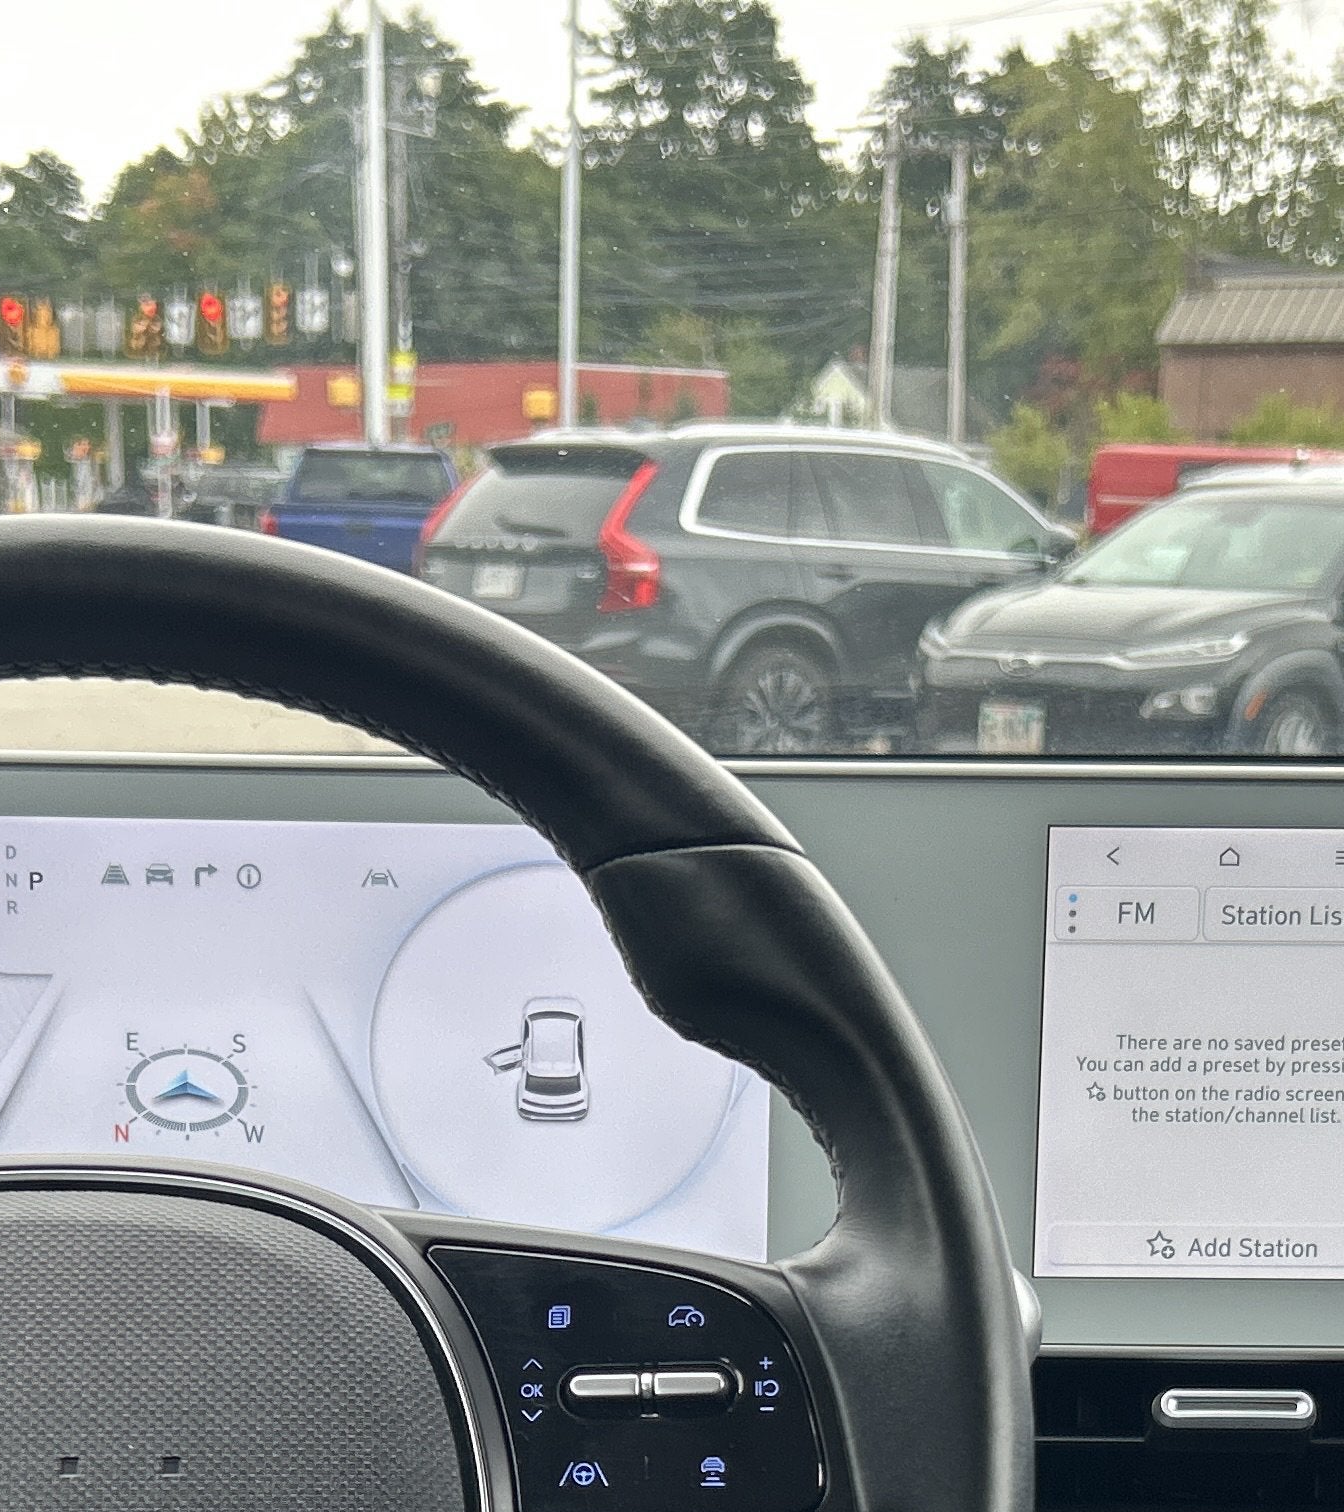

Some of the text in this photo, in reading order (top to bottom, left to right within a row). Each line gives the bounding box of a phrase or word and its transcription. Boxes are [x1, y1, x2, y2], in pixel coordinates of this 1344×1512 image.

[5, 846, 17, 860] D
[6, 872, 44, 890] N P
[6, 900, 19, 915] R
[1118, 902, 1156, 925] FM
[1221, 904, 1301, 926] Station
[126, 1032, 138, 1051] E
[233, 1033, 246, 1053] S
[1117, 1034, 1167, 1052] There
[1172, 1037, 1202, 1052] are
[1207, 1037, 1229, 1052] no
[1234, 1035, 1285, 1053] saved
[1077, 1056, 1107, 1073] You
[1113, 1059, 1144, 1073] can
[1150, 1057, 1181, 1073] add
[1187, 1060, 1197, 1073] a
[1203, 1058, 1260, 1077] preset
[1265, 1058, 1286, 1077] by
[1113, 1085, 1169, 1101] button
[1175, 1088, 1196, 1101] on
[1201, 1086, 1230, 1101] the
[1235, 1086, 1280, 1102] radio
[1285, 1088, 1344, 1102] screen
[1131, 1106, 1342, 1124] the station/channel list.
[114, 1123, 129, 1143] N
[243, 1124, 265, 1143] W
[1188, 1237, 1318, 1259] Add Station
[520, 1384, 544, 1398] OK
